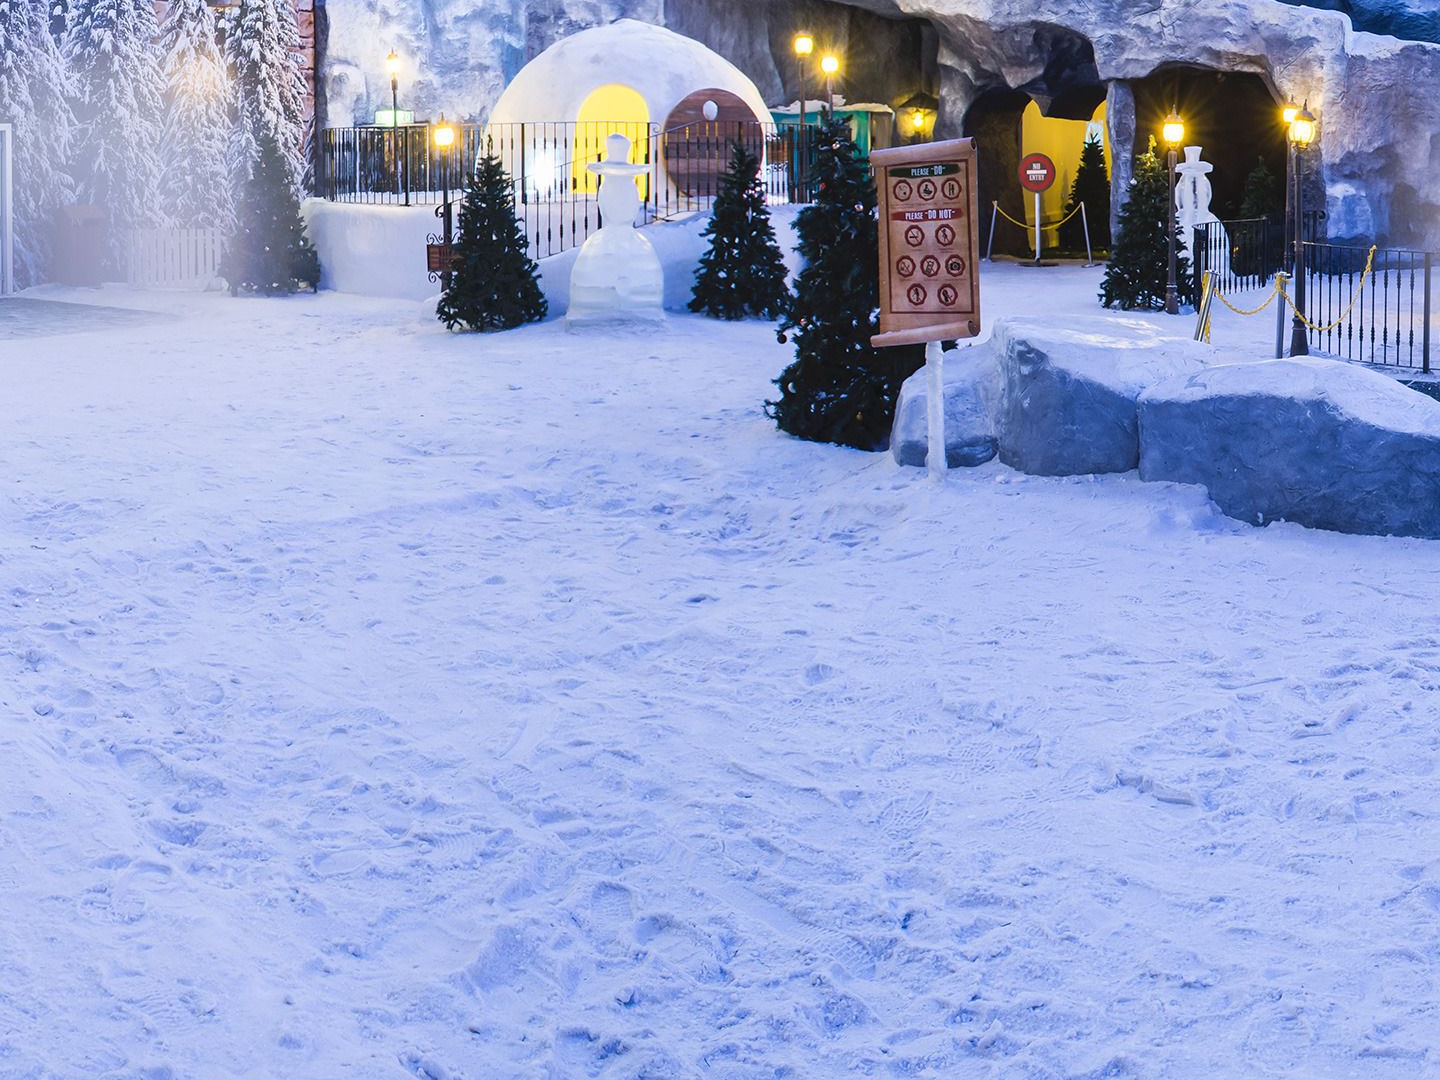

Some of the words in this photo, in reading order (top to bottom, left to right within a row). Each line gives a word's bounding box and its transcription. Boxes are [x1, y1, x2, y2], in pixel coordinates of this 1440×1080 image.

[1032, 162, 1041, 170] NO
[911, 167, 929, 177] PLEASE
[905, 211, 924, 220] PLEASE
